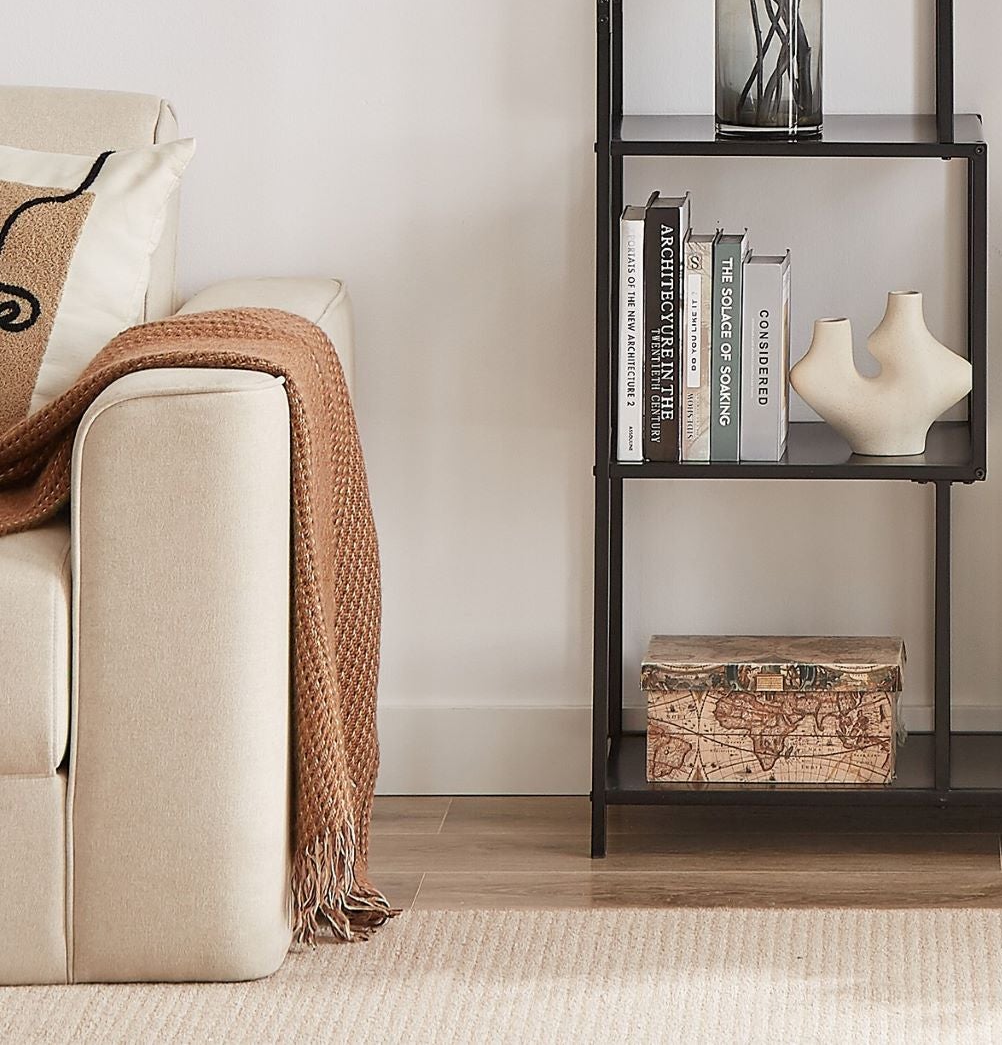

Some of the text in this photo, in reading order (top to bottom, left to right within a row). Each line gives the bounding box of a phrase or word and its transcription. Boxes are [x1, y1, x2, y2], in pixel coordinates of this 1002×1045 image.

[690, 255, 700, 270] S
[627, 276, 636, 289] OF
[627, 291, 636, 308] THE
[690, 299, 698, 309] IT
[627, 310, 636, 331] NEW
[659, 224, 674, 421] ARCHITECYURE IN THE
[690, 311, 698, 333] LIKE
[690, 335, 698, 354] YOU
[718, 257, 734, 427] THE SOLACE OF SOAKING
[627, 334, 636, 398] ARCHITECTURE
[690, 357, 698, 372] DO
[758, 309, 770, 406] CONSIDERED
[650, 328, 661, 444] TWENTIETH CENTURY
